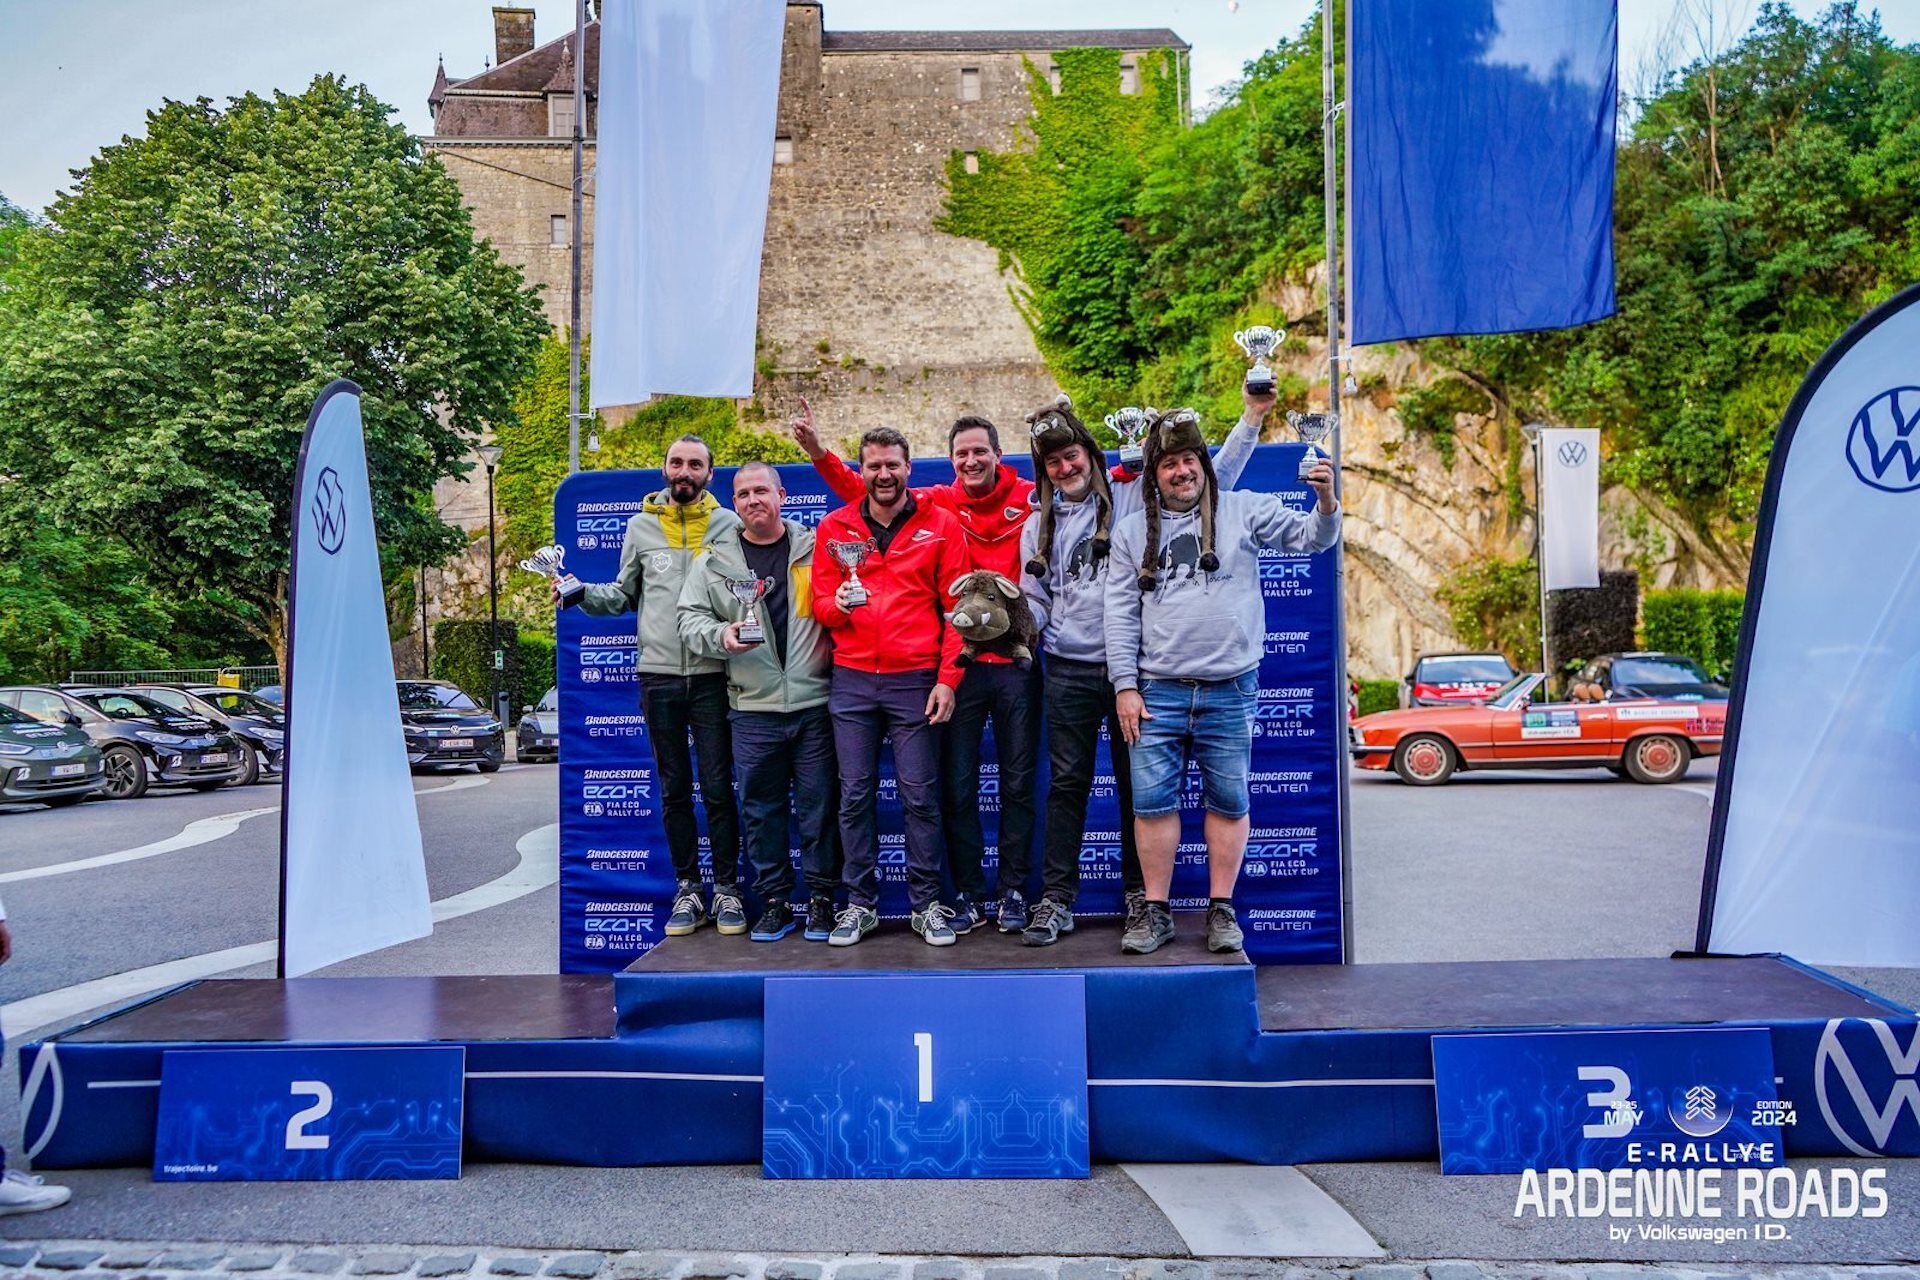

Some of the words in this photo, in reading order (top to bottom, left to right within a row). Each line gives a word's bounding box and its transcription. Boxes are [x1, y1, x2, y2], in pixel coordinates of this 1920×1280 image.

[1281, 580, 1300, 588] ECO
[1294, 588, 1312, 596] CUP
[585, 715, 646, 725] BRIDGESTONE
[584, 769, 651, 779] BRIDGESTONE
[1248, 772, 1313, 781] BRIDGESTONE
[586, 849, 650, 859] BRIDGESTONE
[1270, 860, 1285, 868] FIA
[585, 902, 654, 912] BRIDGESTONE
[1248, 909, 1316, 919] BRIDGESTONE
[637, 942, 654, 950] CUP
[913, 1032, 933, 1102] 1
[1577, 1066, 1633, 1138] 3
[285, 1080, 333, 1150] 2
